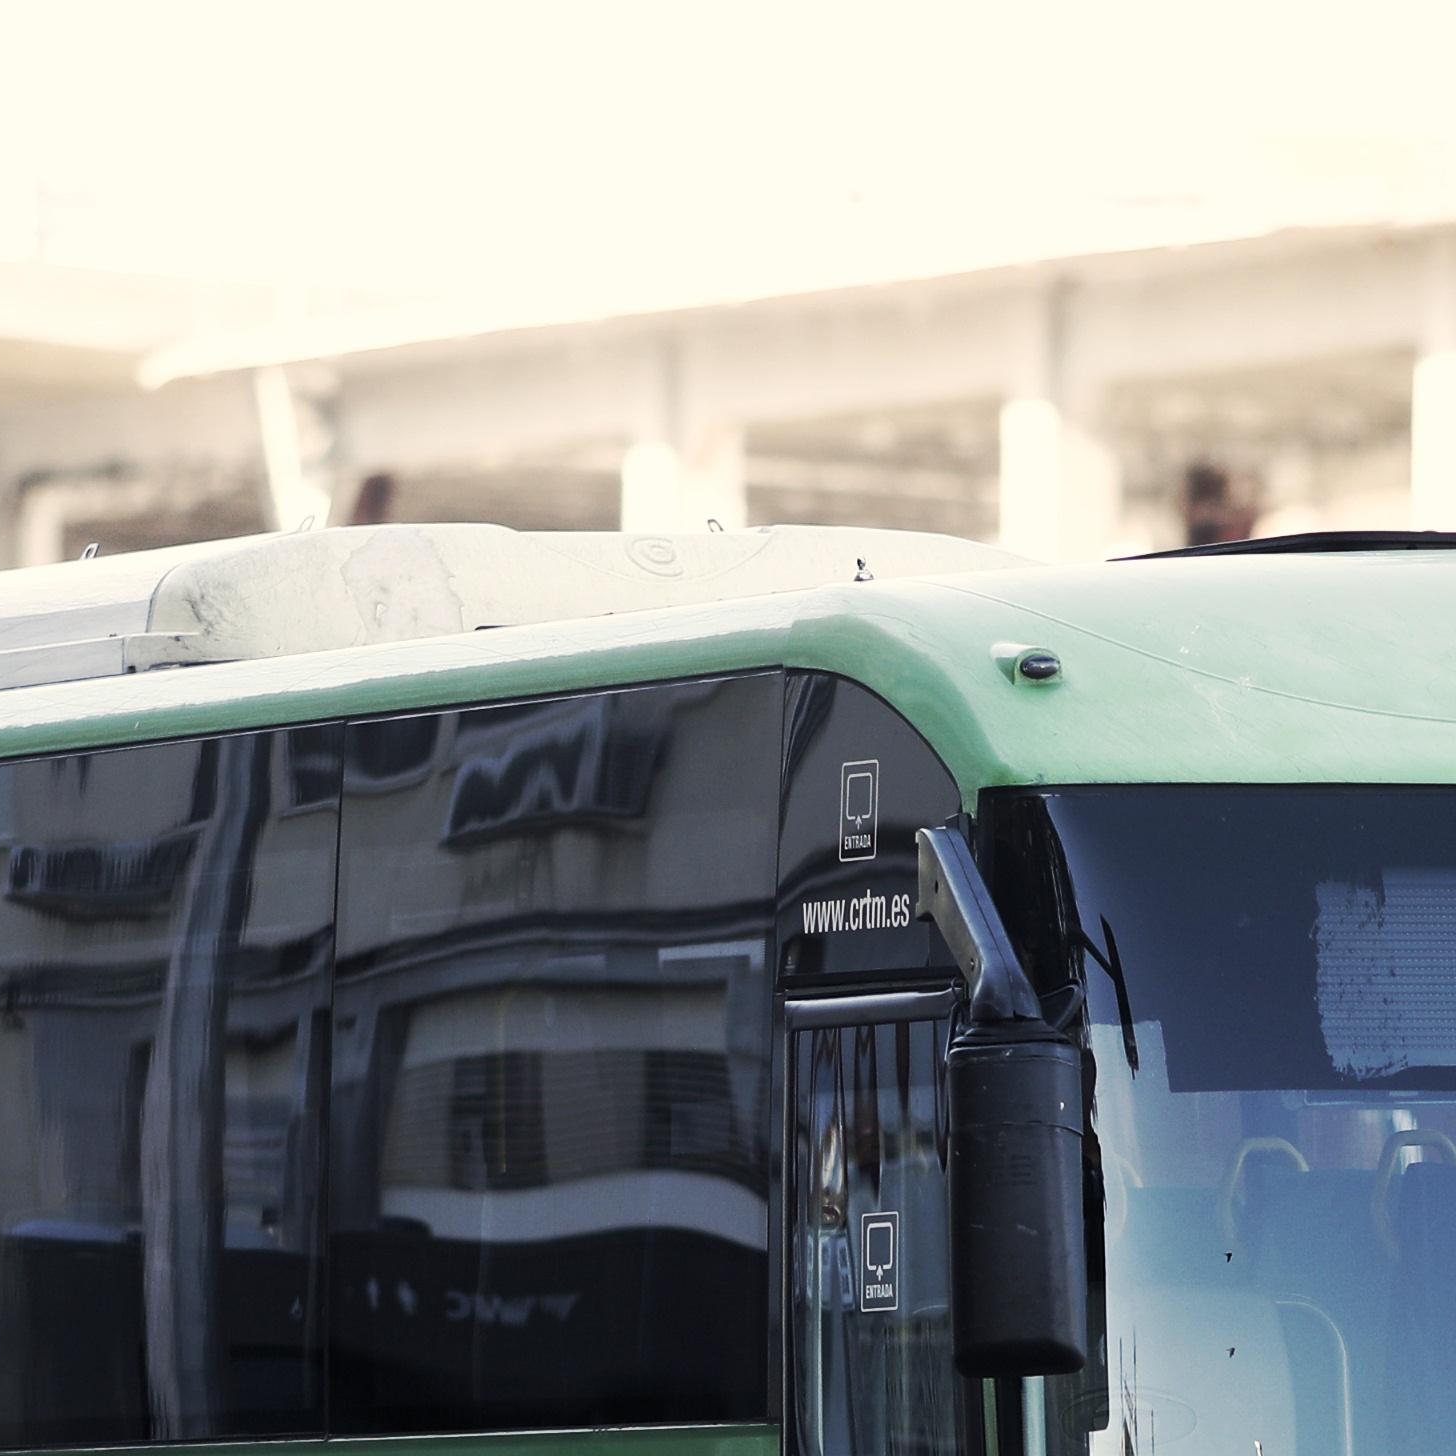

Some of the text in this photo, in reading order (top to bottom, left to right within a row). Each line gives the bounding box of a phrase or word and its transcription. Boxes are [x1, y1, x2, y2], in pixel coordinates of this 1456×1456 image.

[844, 834, 872, 850] ENTRADA
[802, 888, 910, 934] www.crtm.es
[865, 1283, 894, 1300] ENTRADA
